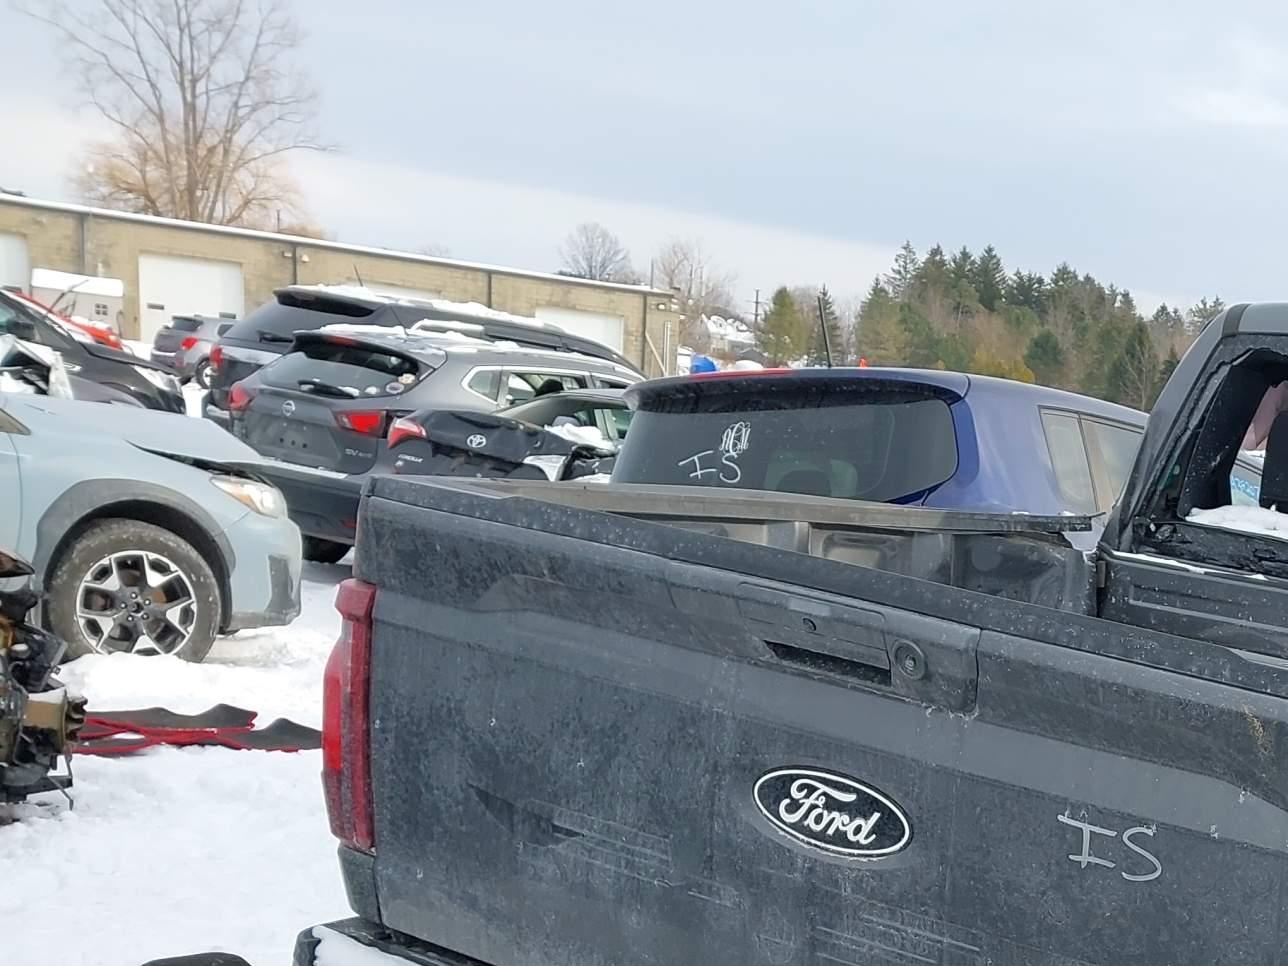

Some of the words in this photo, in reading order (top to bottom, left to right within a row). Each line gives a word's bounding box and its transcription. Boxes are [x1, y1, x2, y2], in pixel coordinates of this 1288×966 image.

[678, 449, 741, 484] IS
[778, 778, 881, 846] Ford
[1057, 806, 1162, 882] IS
